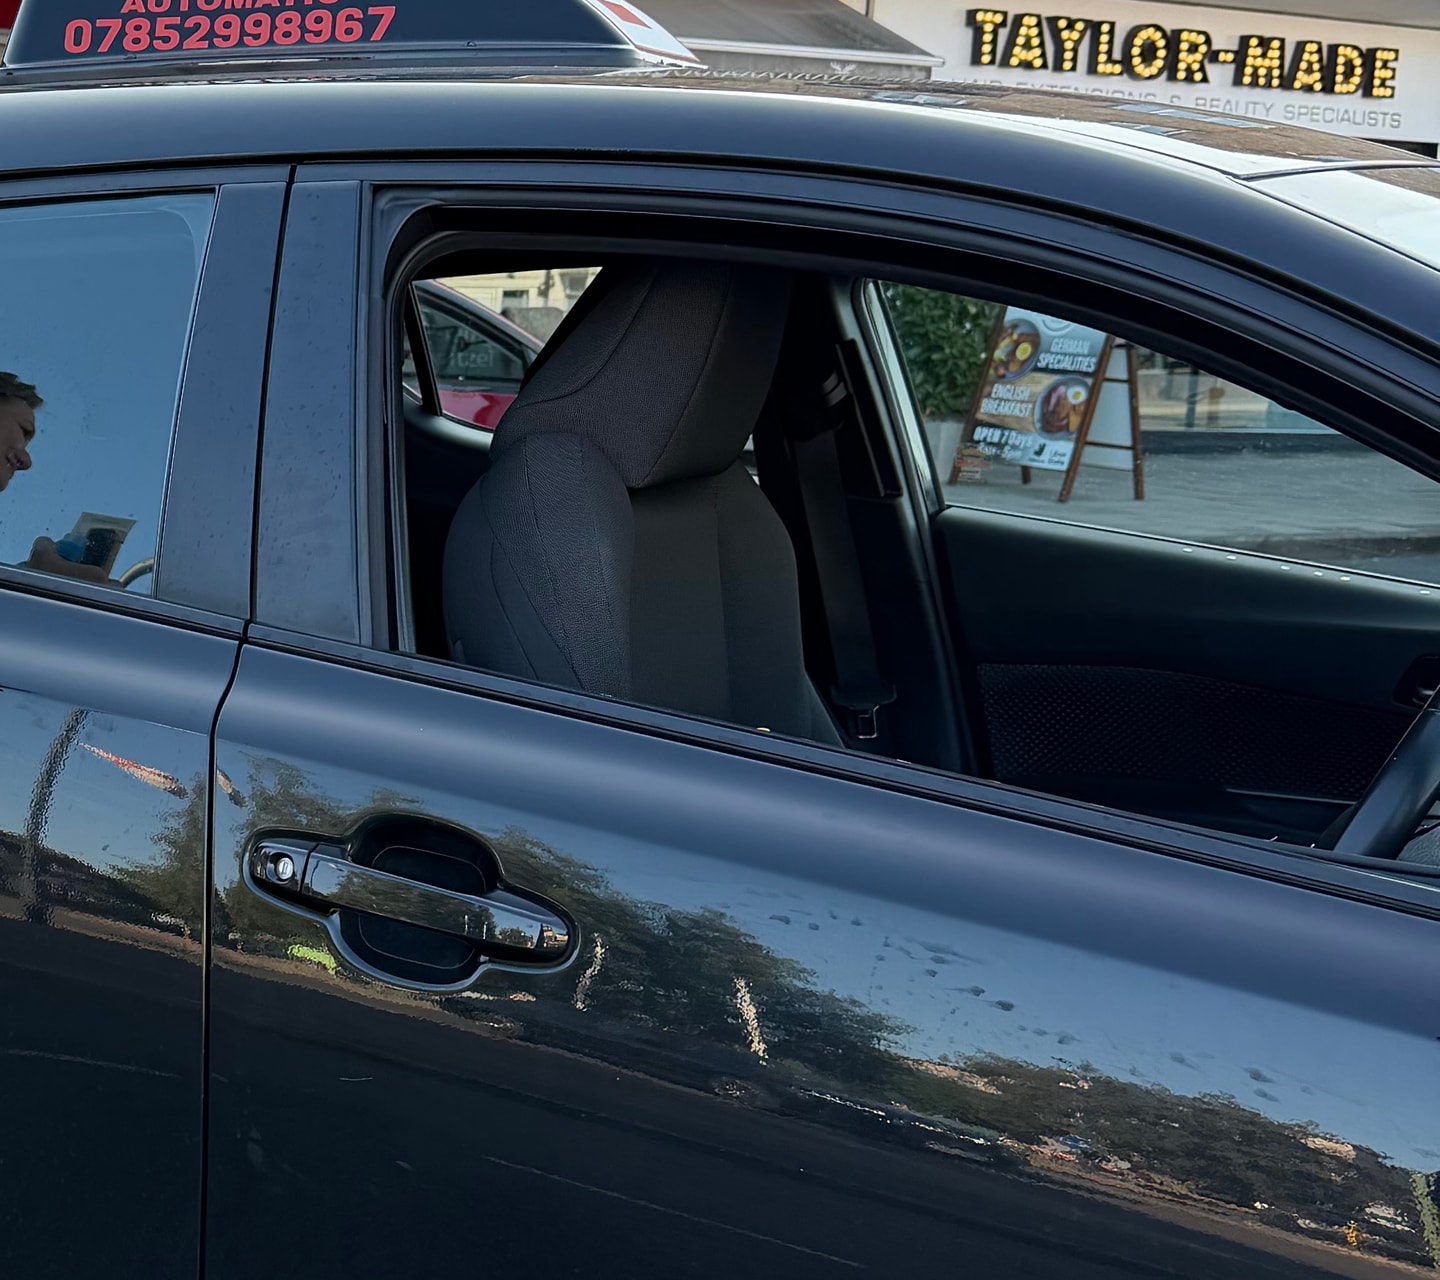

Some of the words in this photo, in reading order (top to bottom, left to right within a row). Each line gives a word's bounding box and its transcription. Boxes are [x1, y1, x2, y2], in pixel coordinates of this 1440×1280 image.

[63, 6, 396, 54] 07852998967
[966, 8, 1400, 99] TAYLOR-MADE
[1283, 104, 1402, 130] SPECIALISTS
[1050, 338, 1091, 354] GERMAN
[1037, 353, 1097, 372] SPECIALITIES
[991, 383, 1031, 401] ENGLISH
[980, 398, 1033, 418] BREAKFAST
[973, 425, 1001, 443] OPEN
